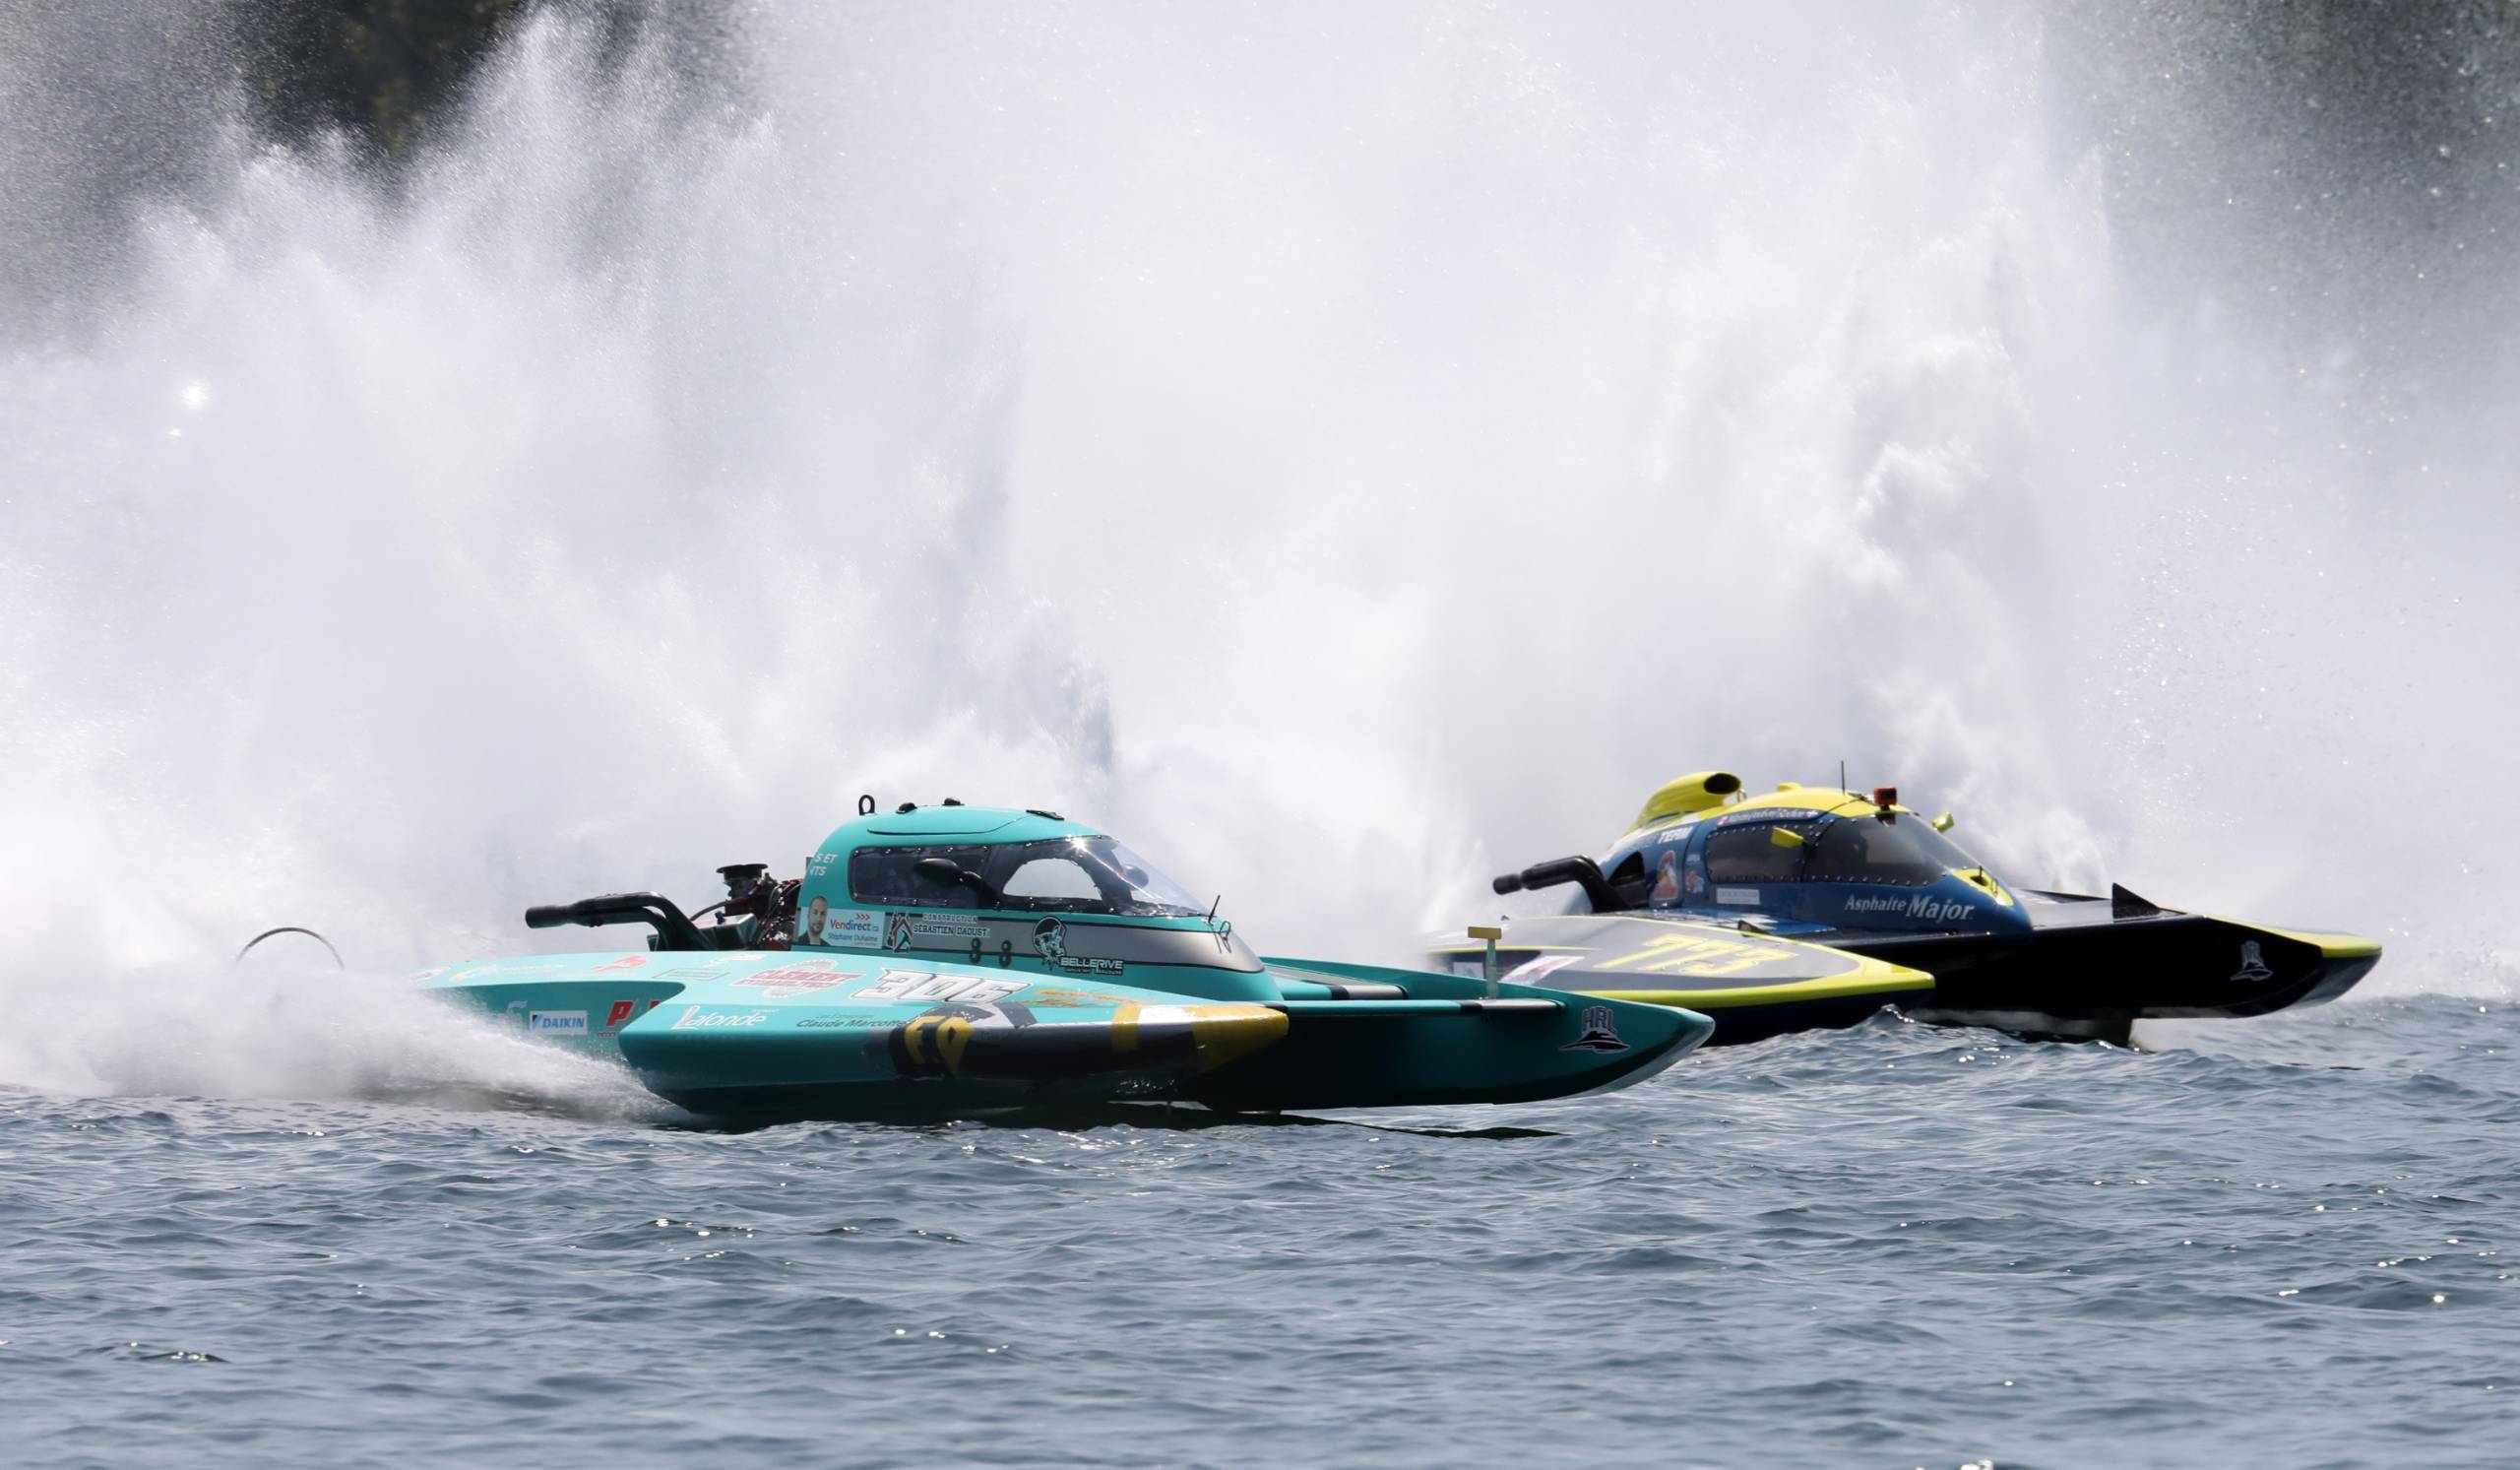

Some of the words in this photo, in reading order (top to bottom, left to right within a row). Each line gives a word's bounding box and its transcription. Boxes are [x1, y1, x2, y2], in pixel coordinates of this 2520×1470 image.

[1844, 895, 1907, 914] Asphalte
[1906, 895, 1976, 924] Major
[1060, 957, 1123, 973] BELLERIVE
[1592, 933, 1800, 977] 773
[852, 969, 1032, 1004] 306
[542, 1016, 586, 1029] DAIKIN
[670, 1004, 768, 1030] Lalonde
[795, 1018, 844, 1028] Claude
